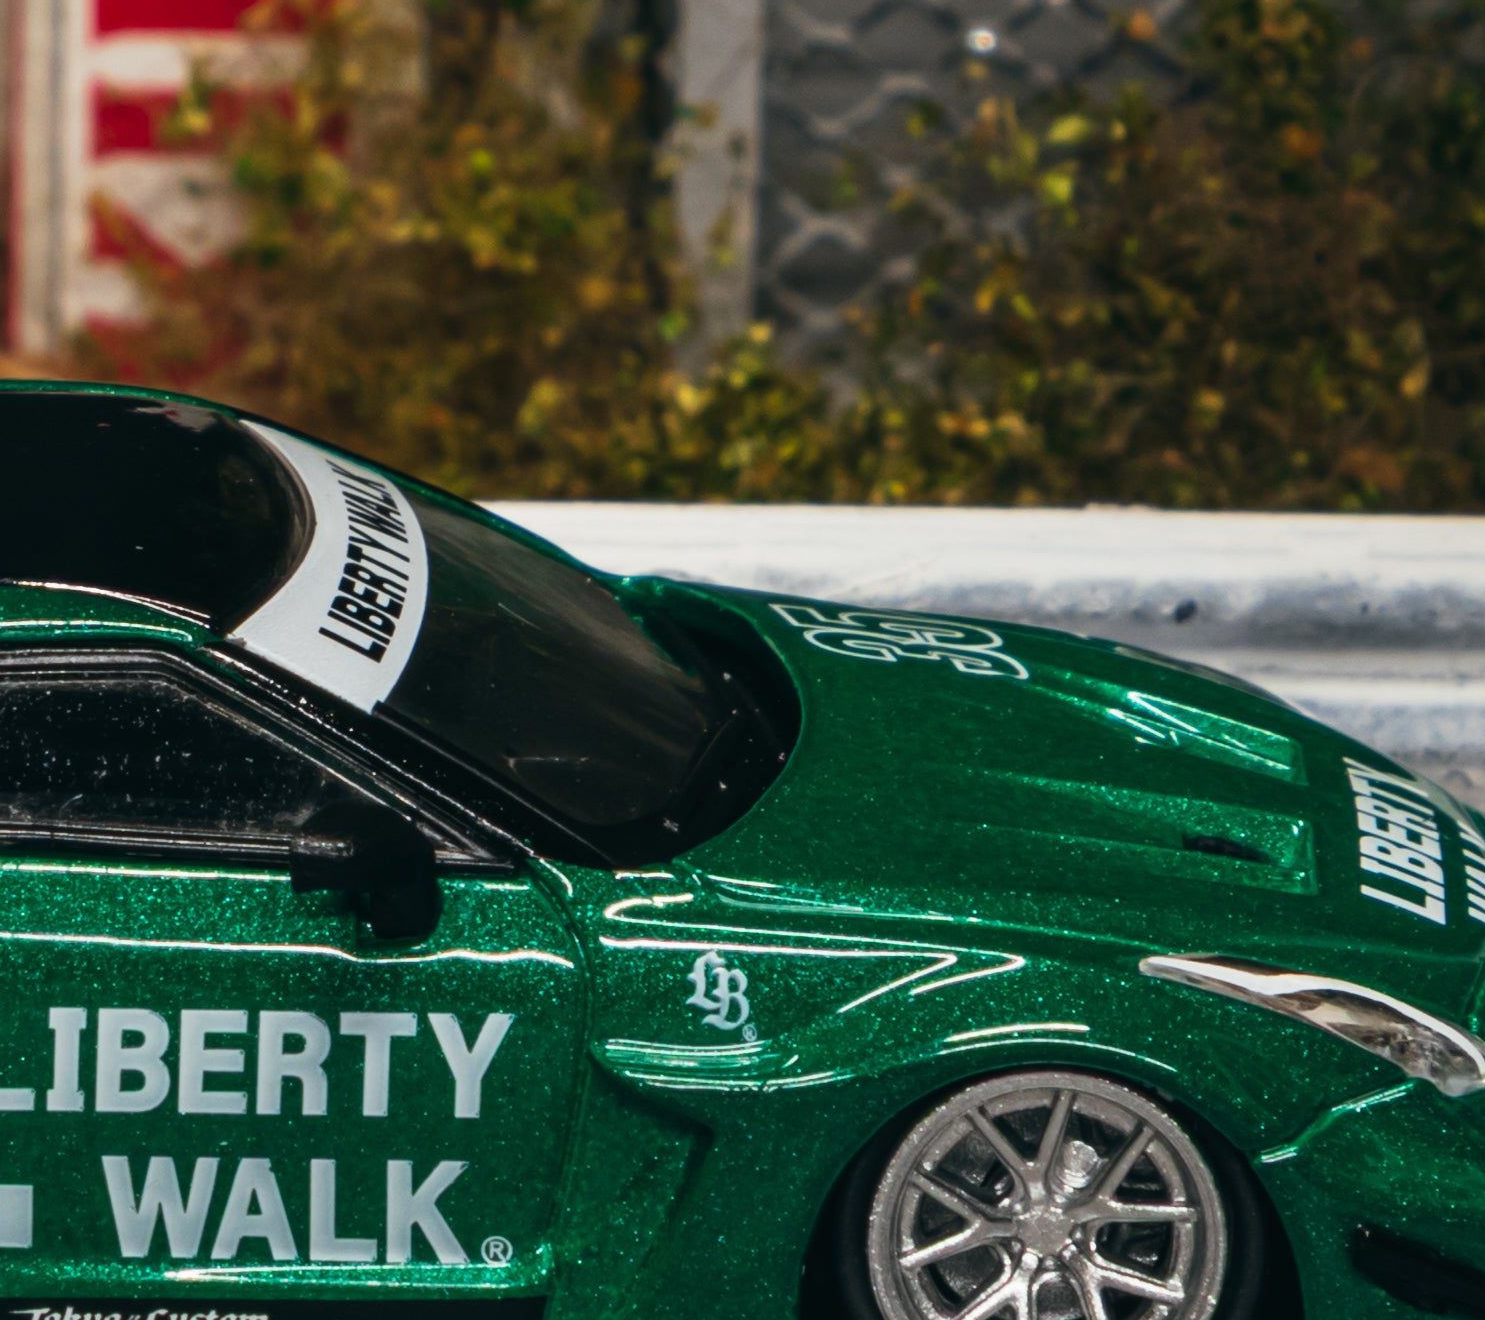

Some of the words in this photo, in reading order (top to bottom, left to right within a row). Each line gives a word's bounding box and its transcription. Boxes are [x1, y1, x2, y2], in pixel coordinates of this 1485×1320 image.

[325, 459, 409, 544] WALK
[318, 525, 411, 663] LIBERTY
[1342, 756, 1447, 926] LIBERTY
[101, 1155, 471, 1265] WALK
